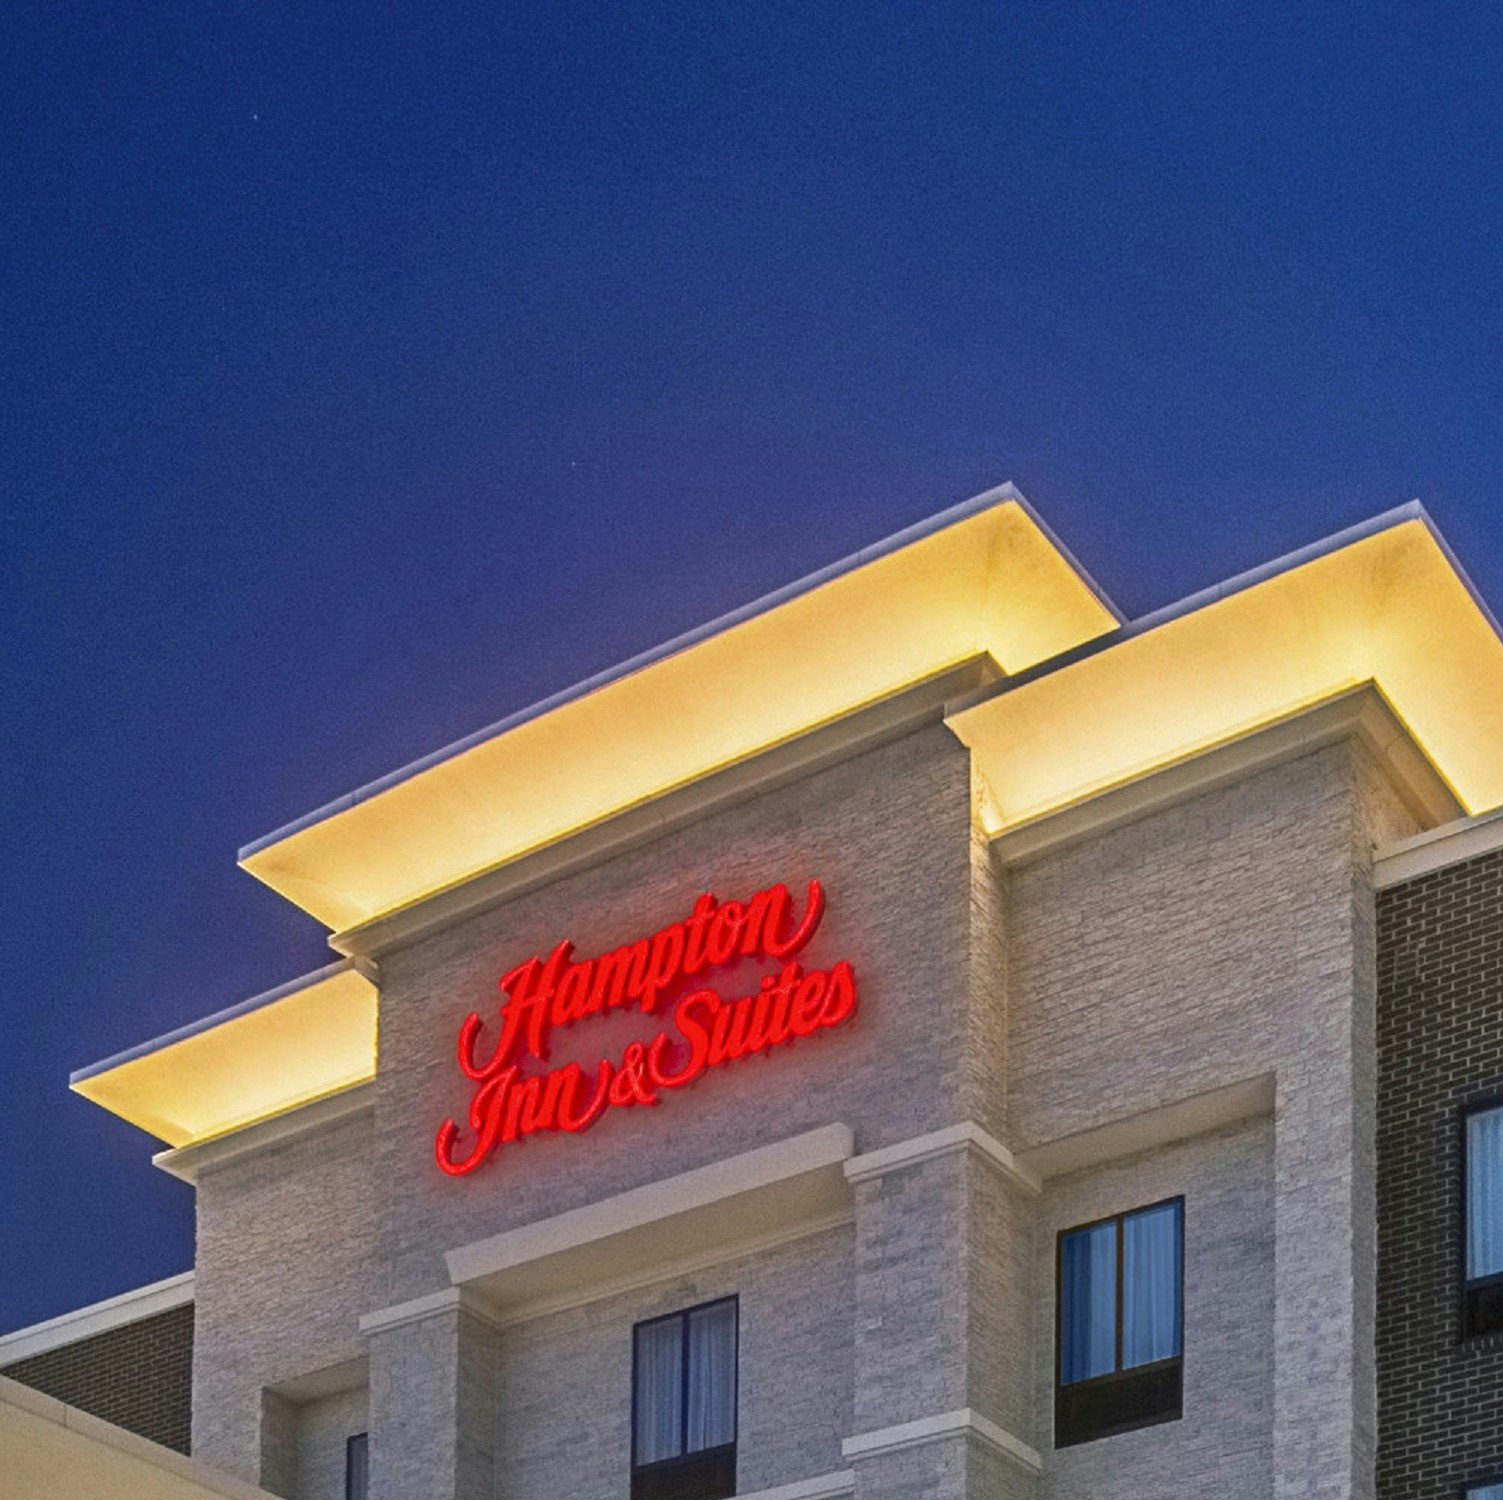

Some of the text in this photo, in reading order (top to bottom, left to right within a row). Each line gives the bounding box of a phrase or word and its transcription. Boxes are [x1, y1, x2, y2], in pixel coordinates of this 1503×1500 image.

[436, 960, 856, 1176] Inn & Suites
[457, 879, 824, 1080] Hampton
